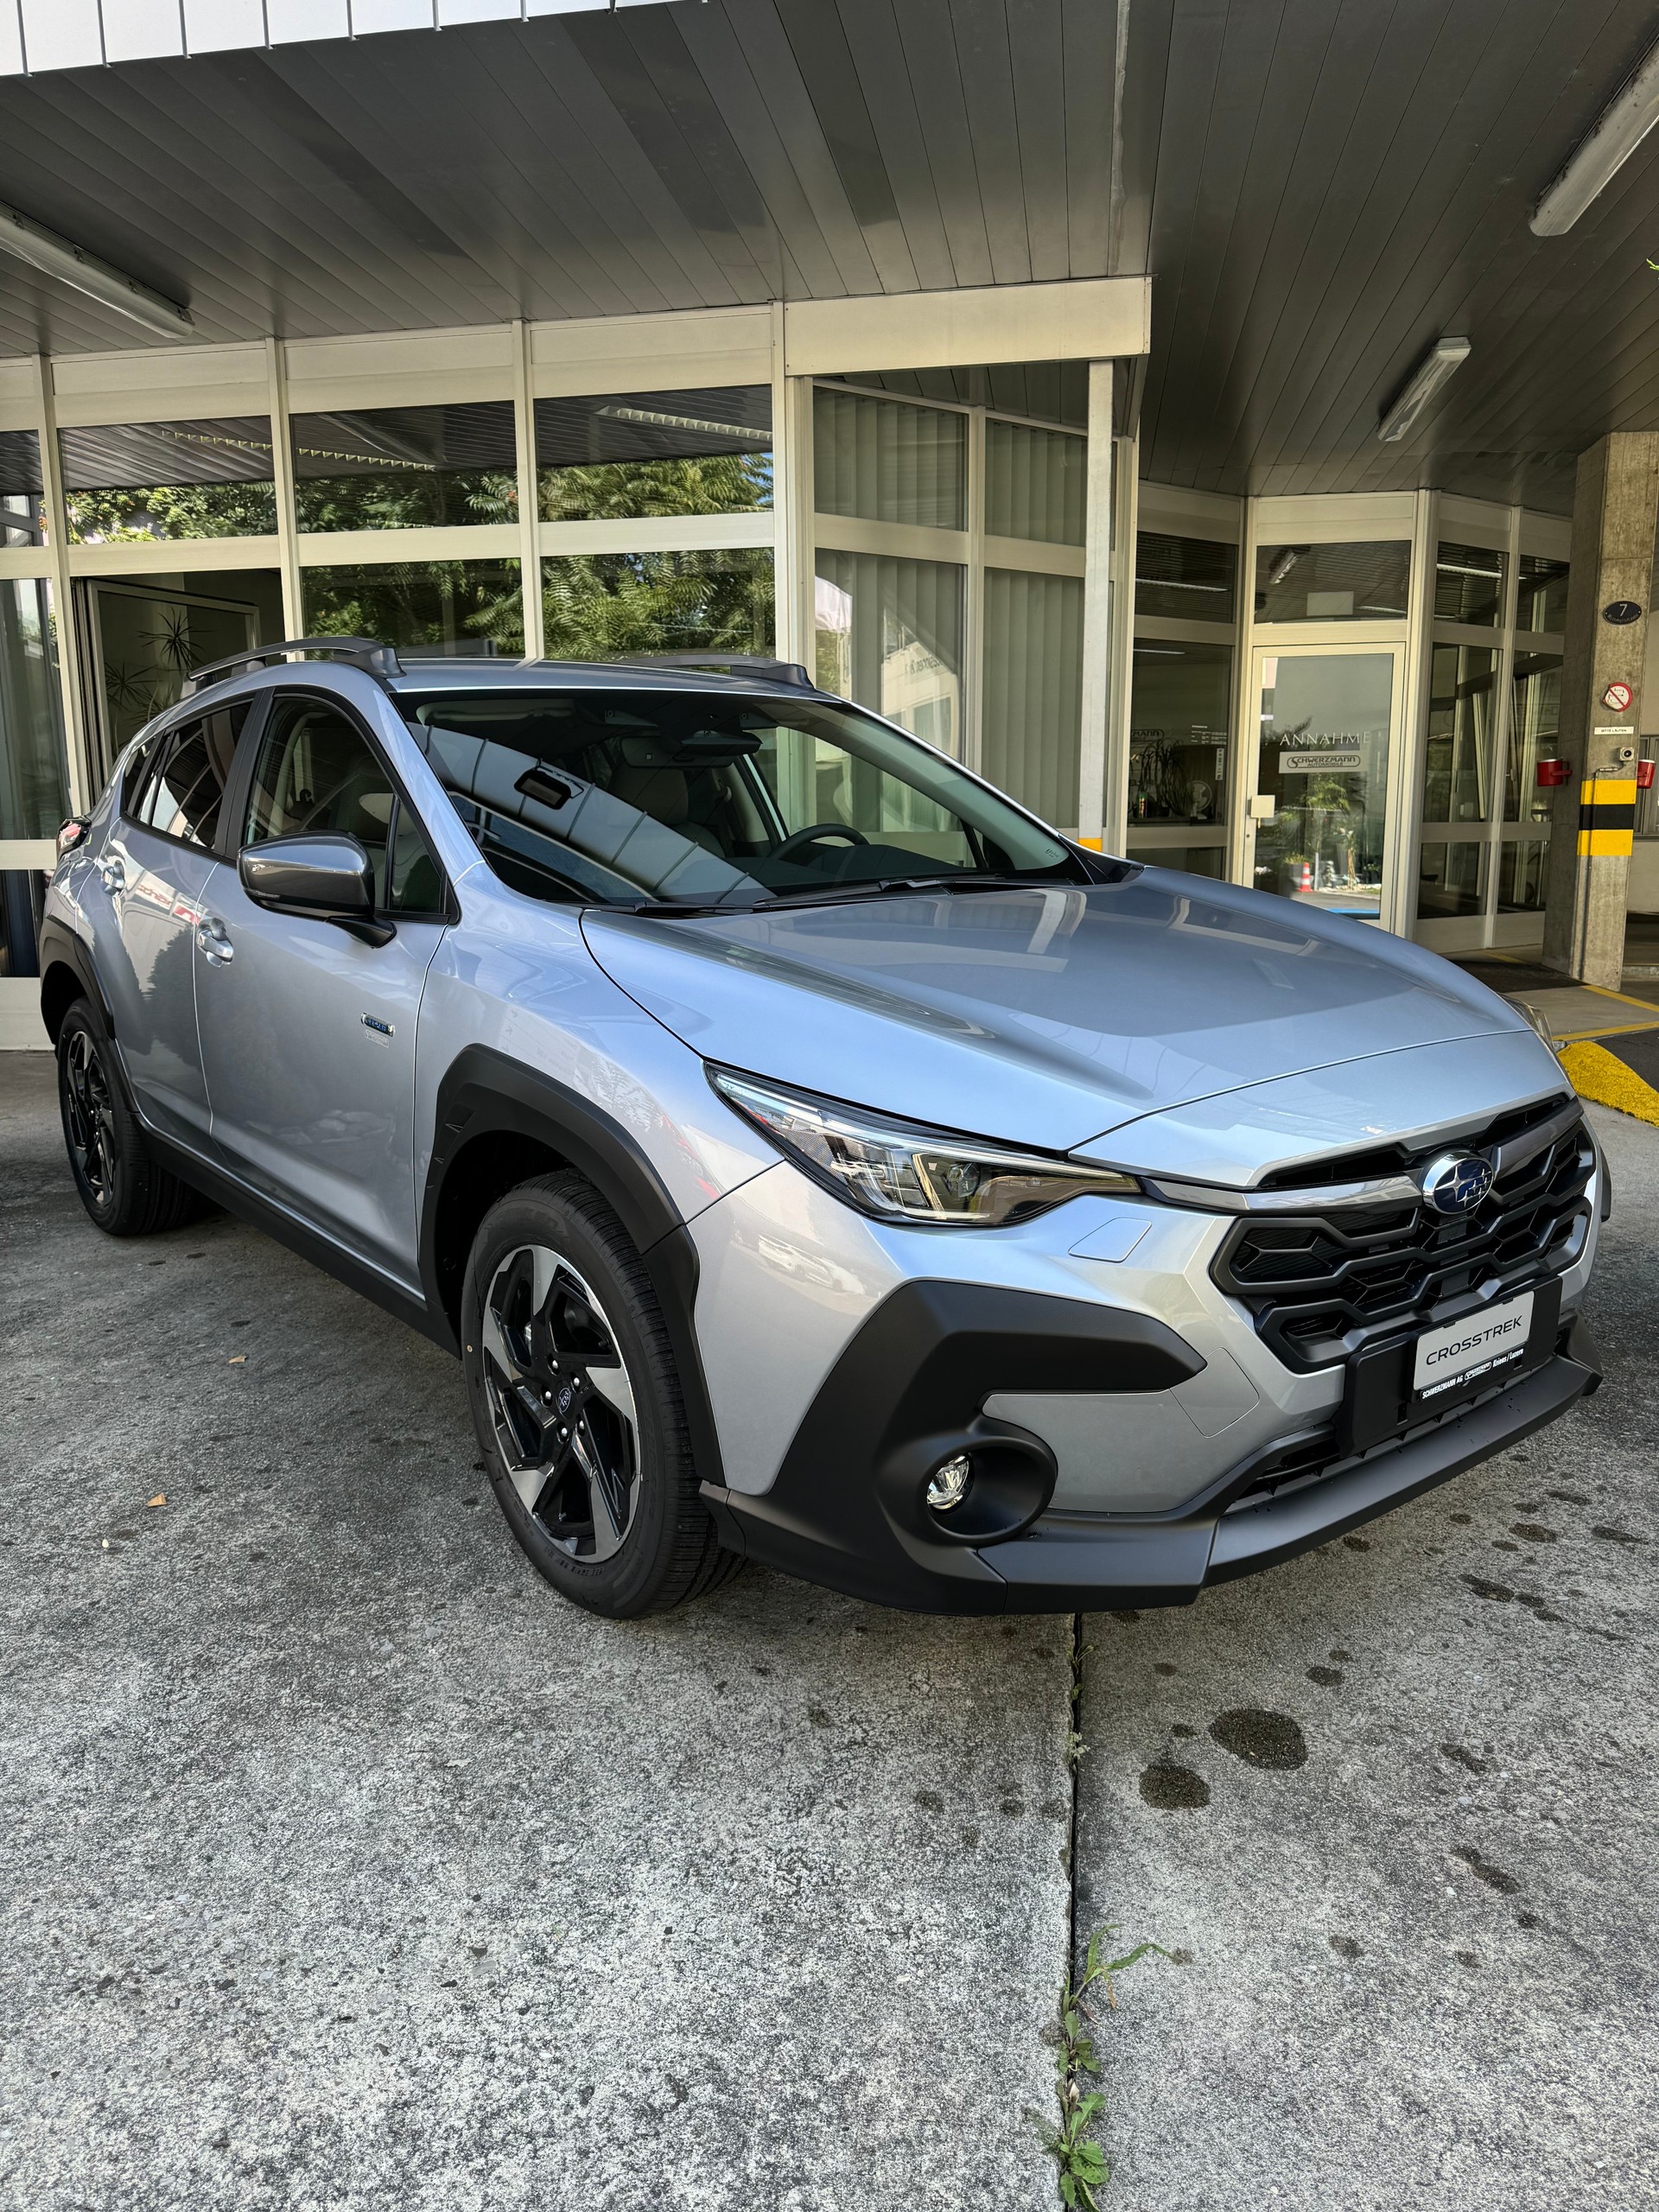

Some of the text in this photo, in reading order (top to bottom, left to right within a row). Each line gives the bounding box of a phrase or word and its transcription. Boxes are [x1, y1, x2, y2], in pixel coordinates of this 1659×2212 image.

[1619, 603, 1629, 617] 7
[1280, 731, 1371, 746] ANNAHME
[1291, 755, 1356, 768] SCHWERZMANN
[1426, 1315, 1523, 1365] CROSSTREK
[1422, 1378, 1457, 1399] SCHWERZMANN
[1456, 1375, 1464, 1384] AG
